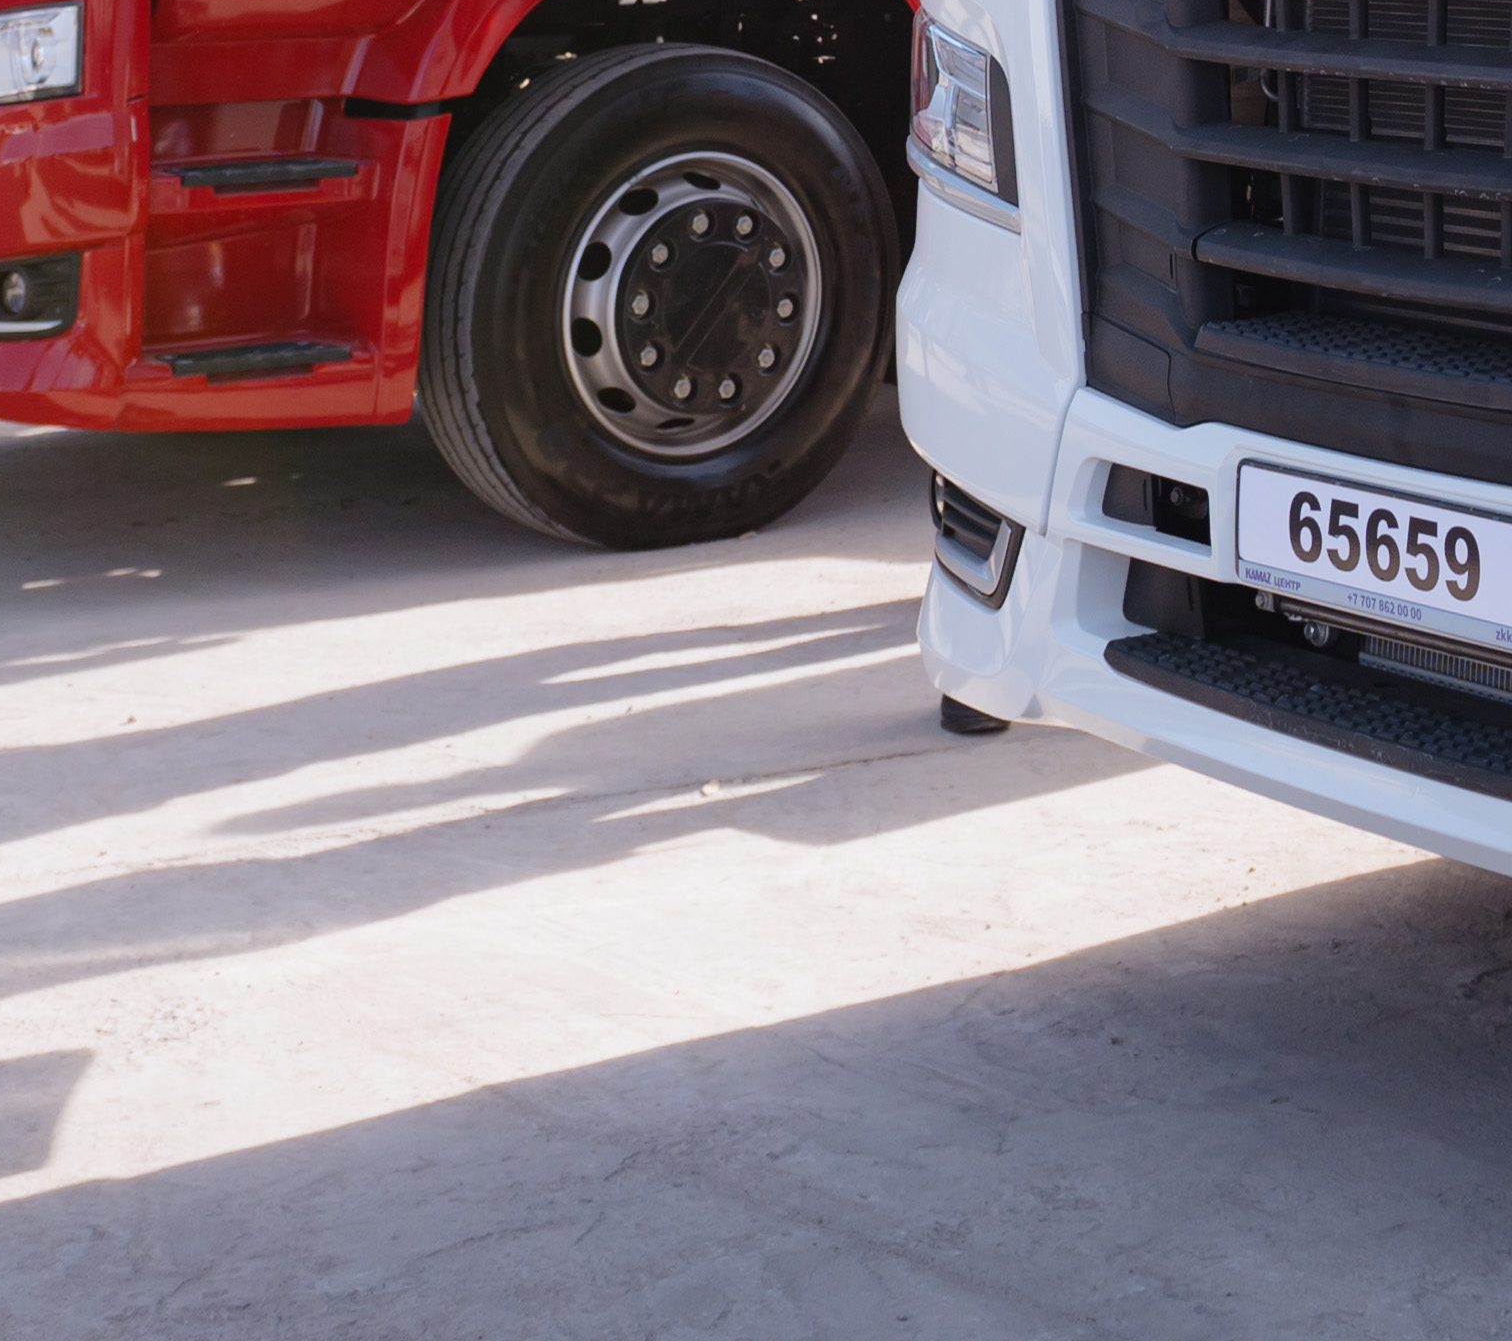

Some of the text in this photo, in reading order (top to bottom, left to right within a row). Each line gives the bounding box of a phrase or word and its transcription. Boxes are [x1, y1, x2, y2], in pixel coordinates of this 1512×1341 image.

[1289, 491, 1481, 602] 65659
[1244, 567, 1301, 592] KAMAZ ЦЕНТР
[1347, 593, 1422, 621] +7 707 862 00 00
